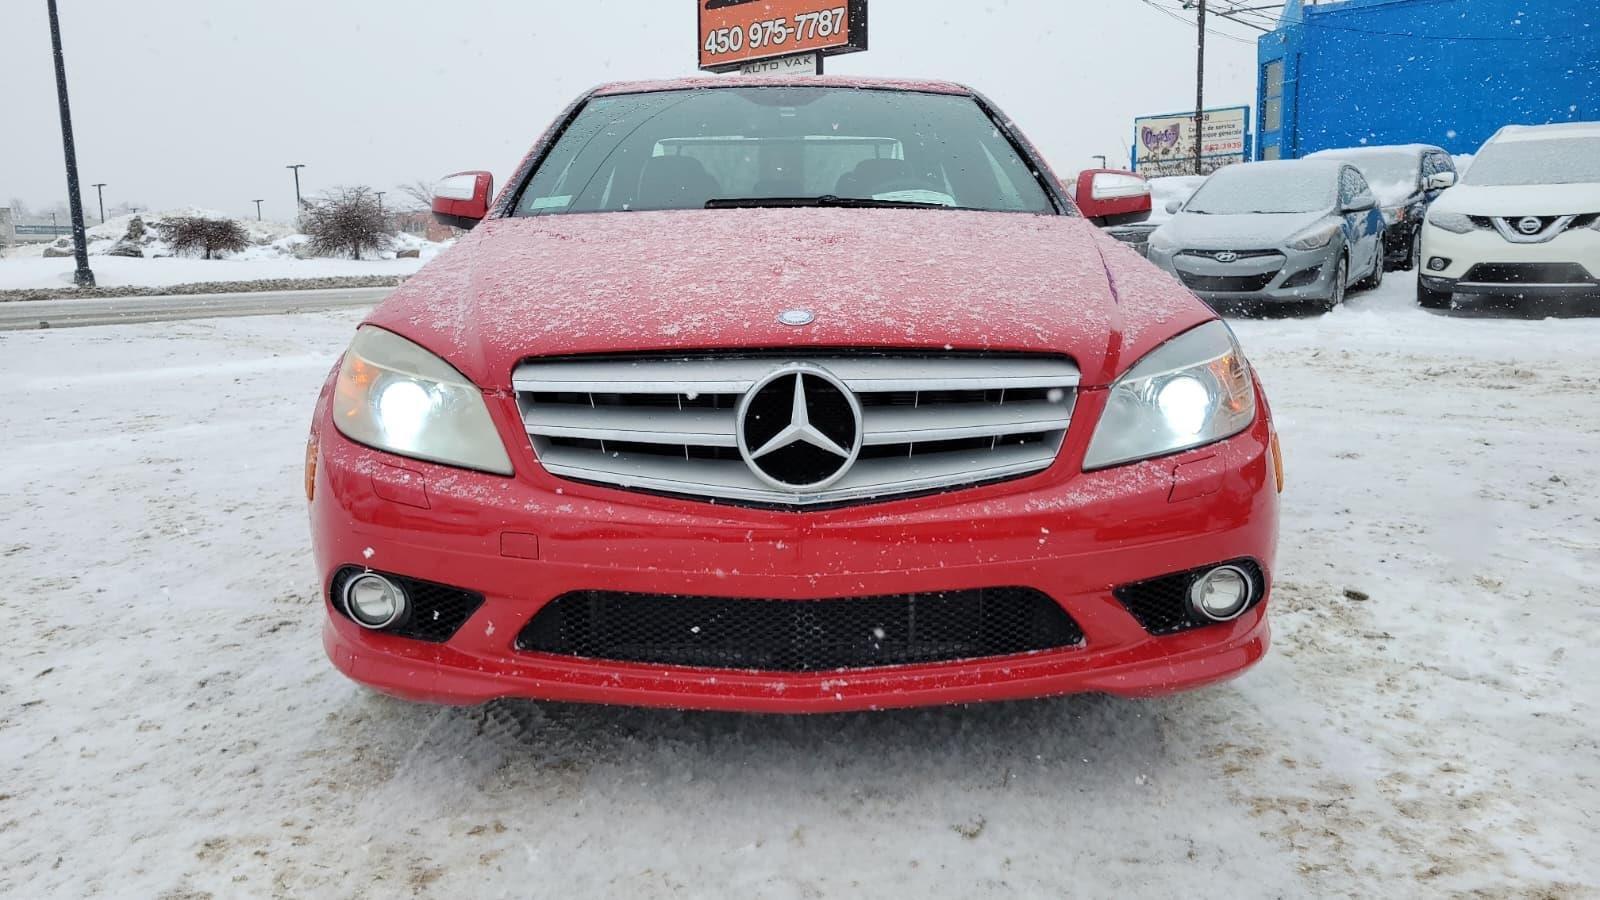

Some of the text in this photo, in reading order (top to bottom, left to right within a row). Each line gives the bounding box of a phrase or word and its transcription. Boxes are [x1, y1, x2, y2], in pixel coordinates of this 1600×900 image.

[704, 7, 845, 55] 450 975-7787
[743, 56, 812, 75] AUTO VAK
